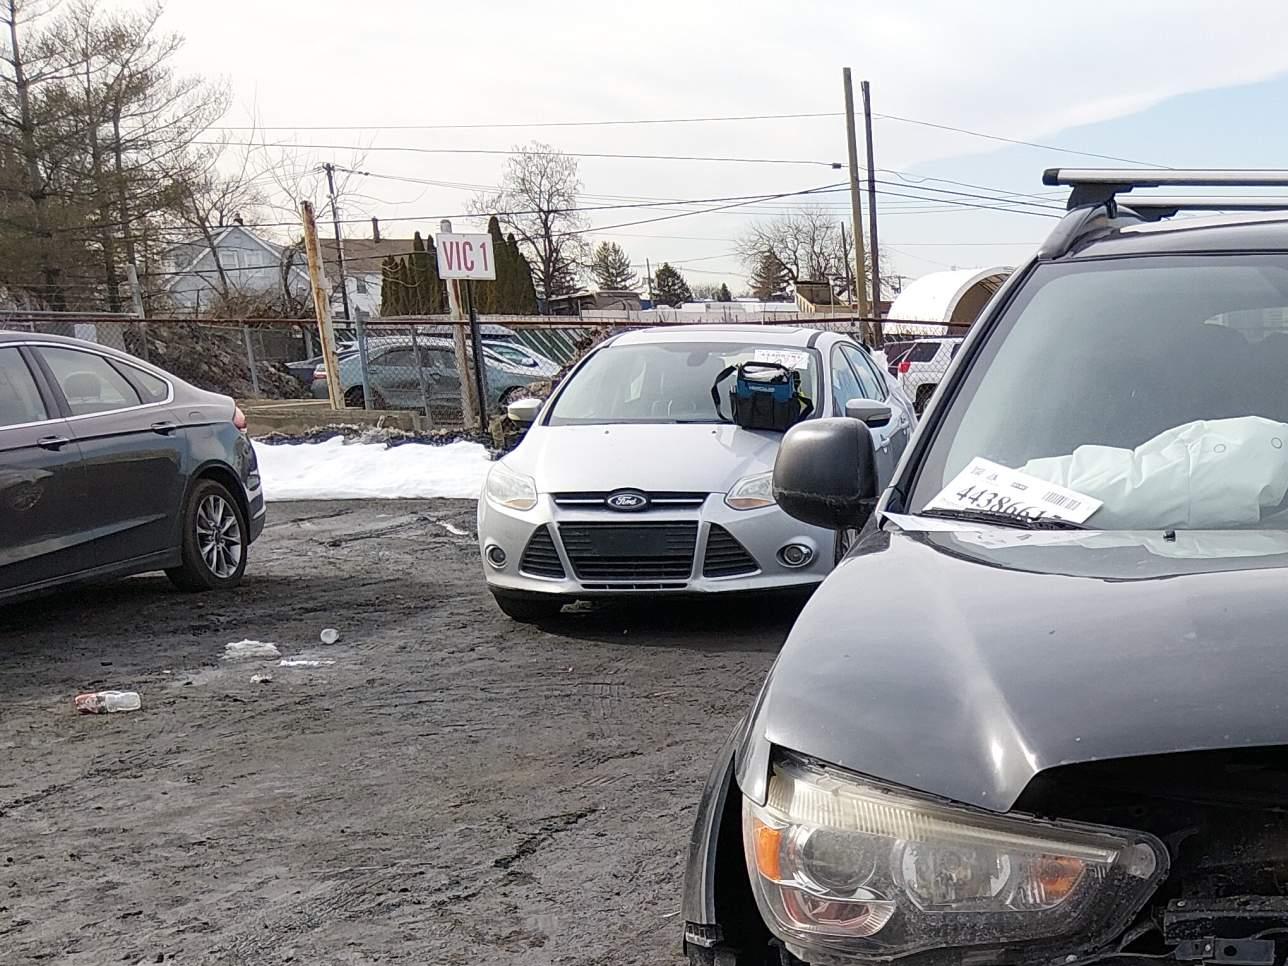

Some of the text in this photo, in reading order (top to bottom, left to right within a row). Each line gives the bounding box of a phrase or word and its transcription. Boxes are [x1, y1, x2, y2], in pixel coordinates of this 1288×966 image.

[442, 241, 488, 271] VIC 1
[616, 496, 637, 505] Ford
